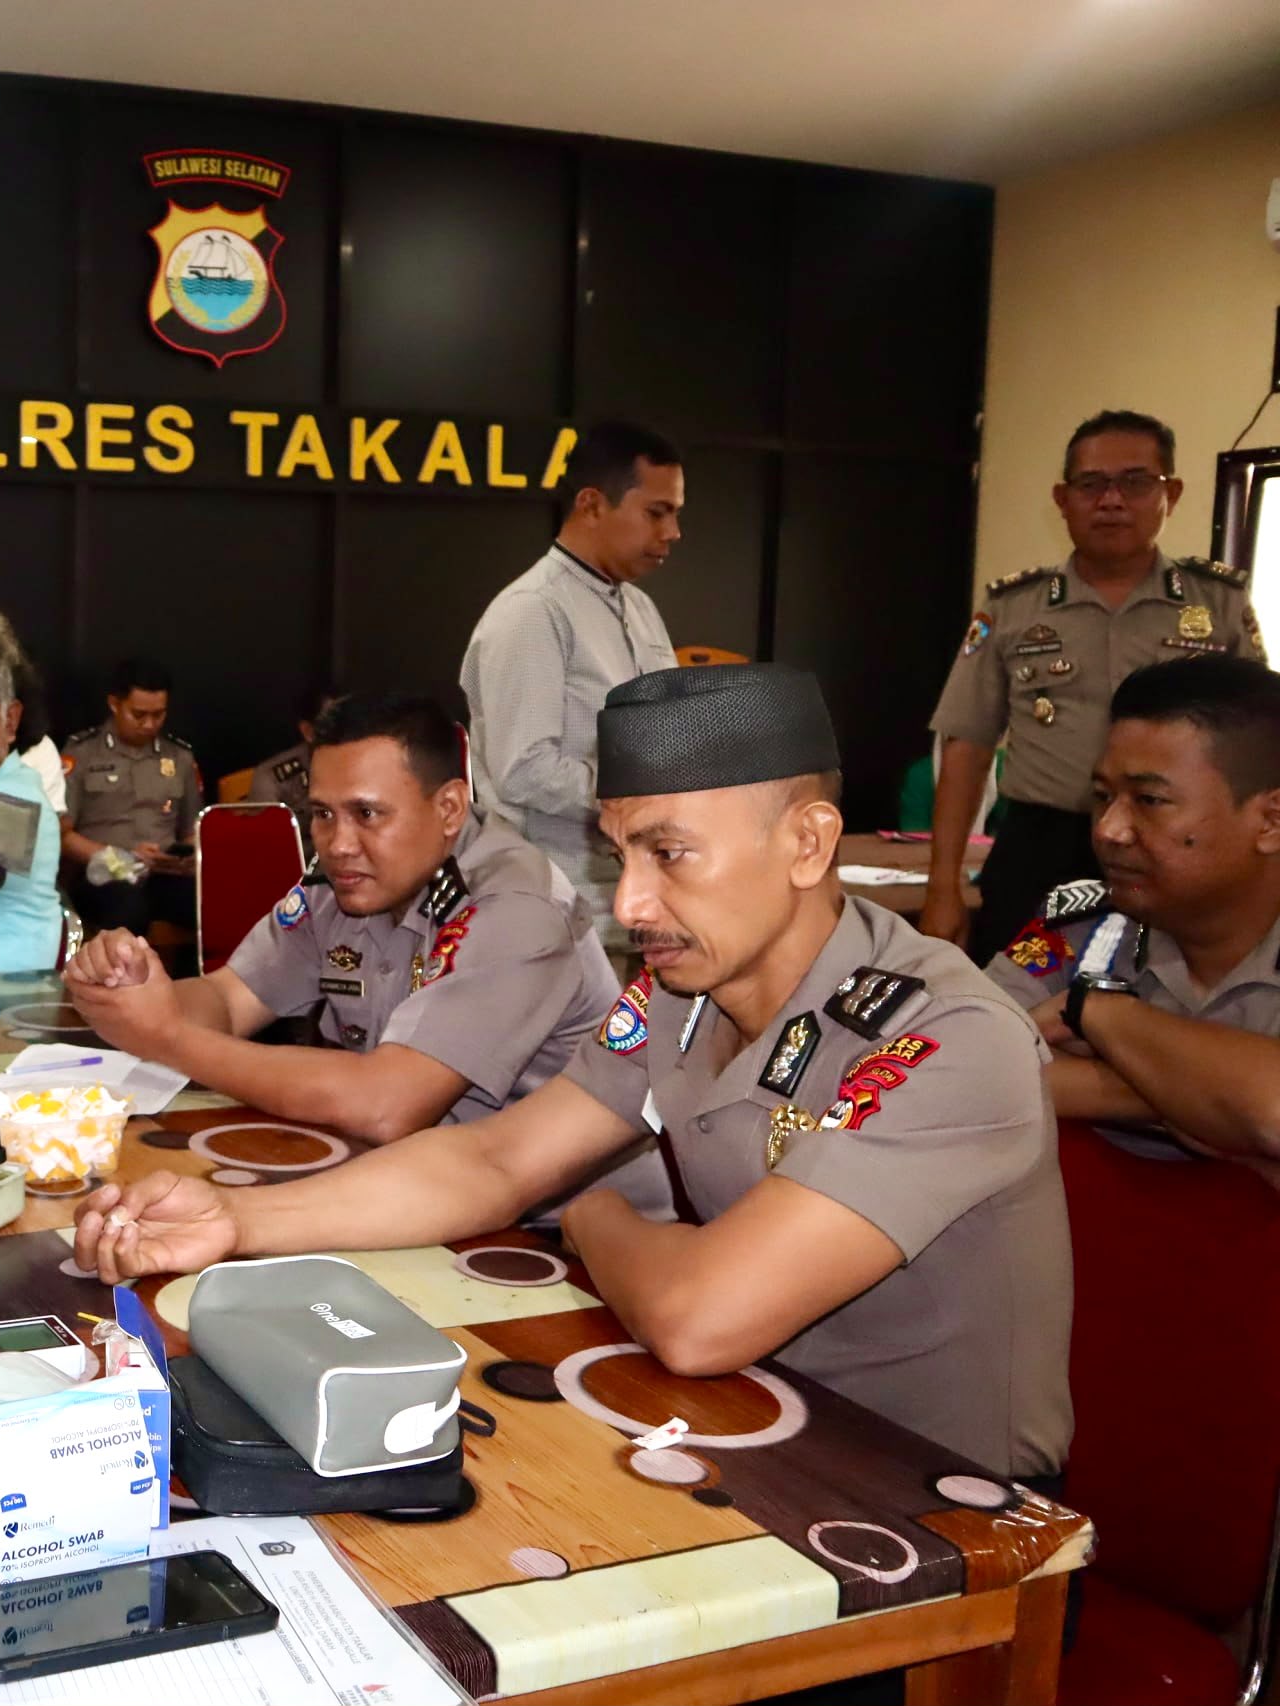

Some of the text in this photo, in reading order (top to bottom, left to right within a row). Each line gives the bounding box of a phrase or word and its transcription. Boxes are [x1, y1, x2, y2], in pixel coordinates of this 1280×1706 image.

[154, 157, 281, 188] SULAWESI SELATAN
[228, 409, 578, 489] TAKALA
[49, 1429, 143, 1461] ALCOHOL SWAB
[20, 1515, 55, 1533] Remedi
[1, 1529, 105, 1562] ALCOHOL SWAB
[20, 1553, 62, 1569] ISOPROPYL
[64, 1543, 100, 1559] ALCOHOL
